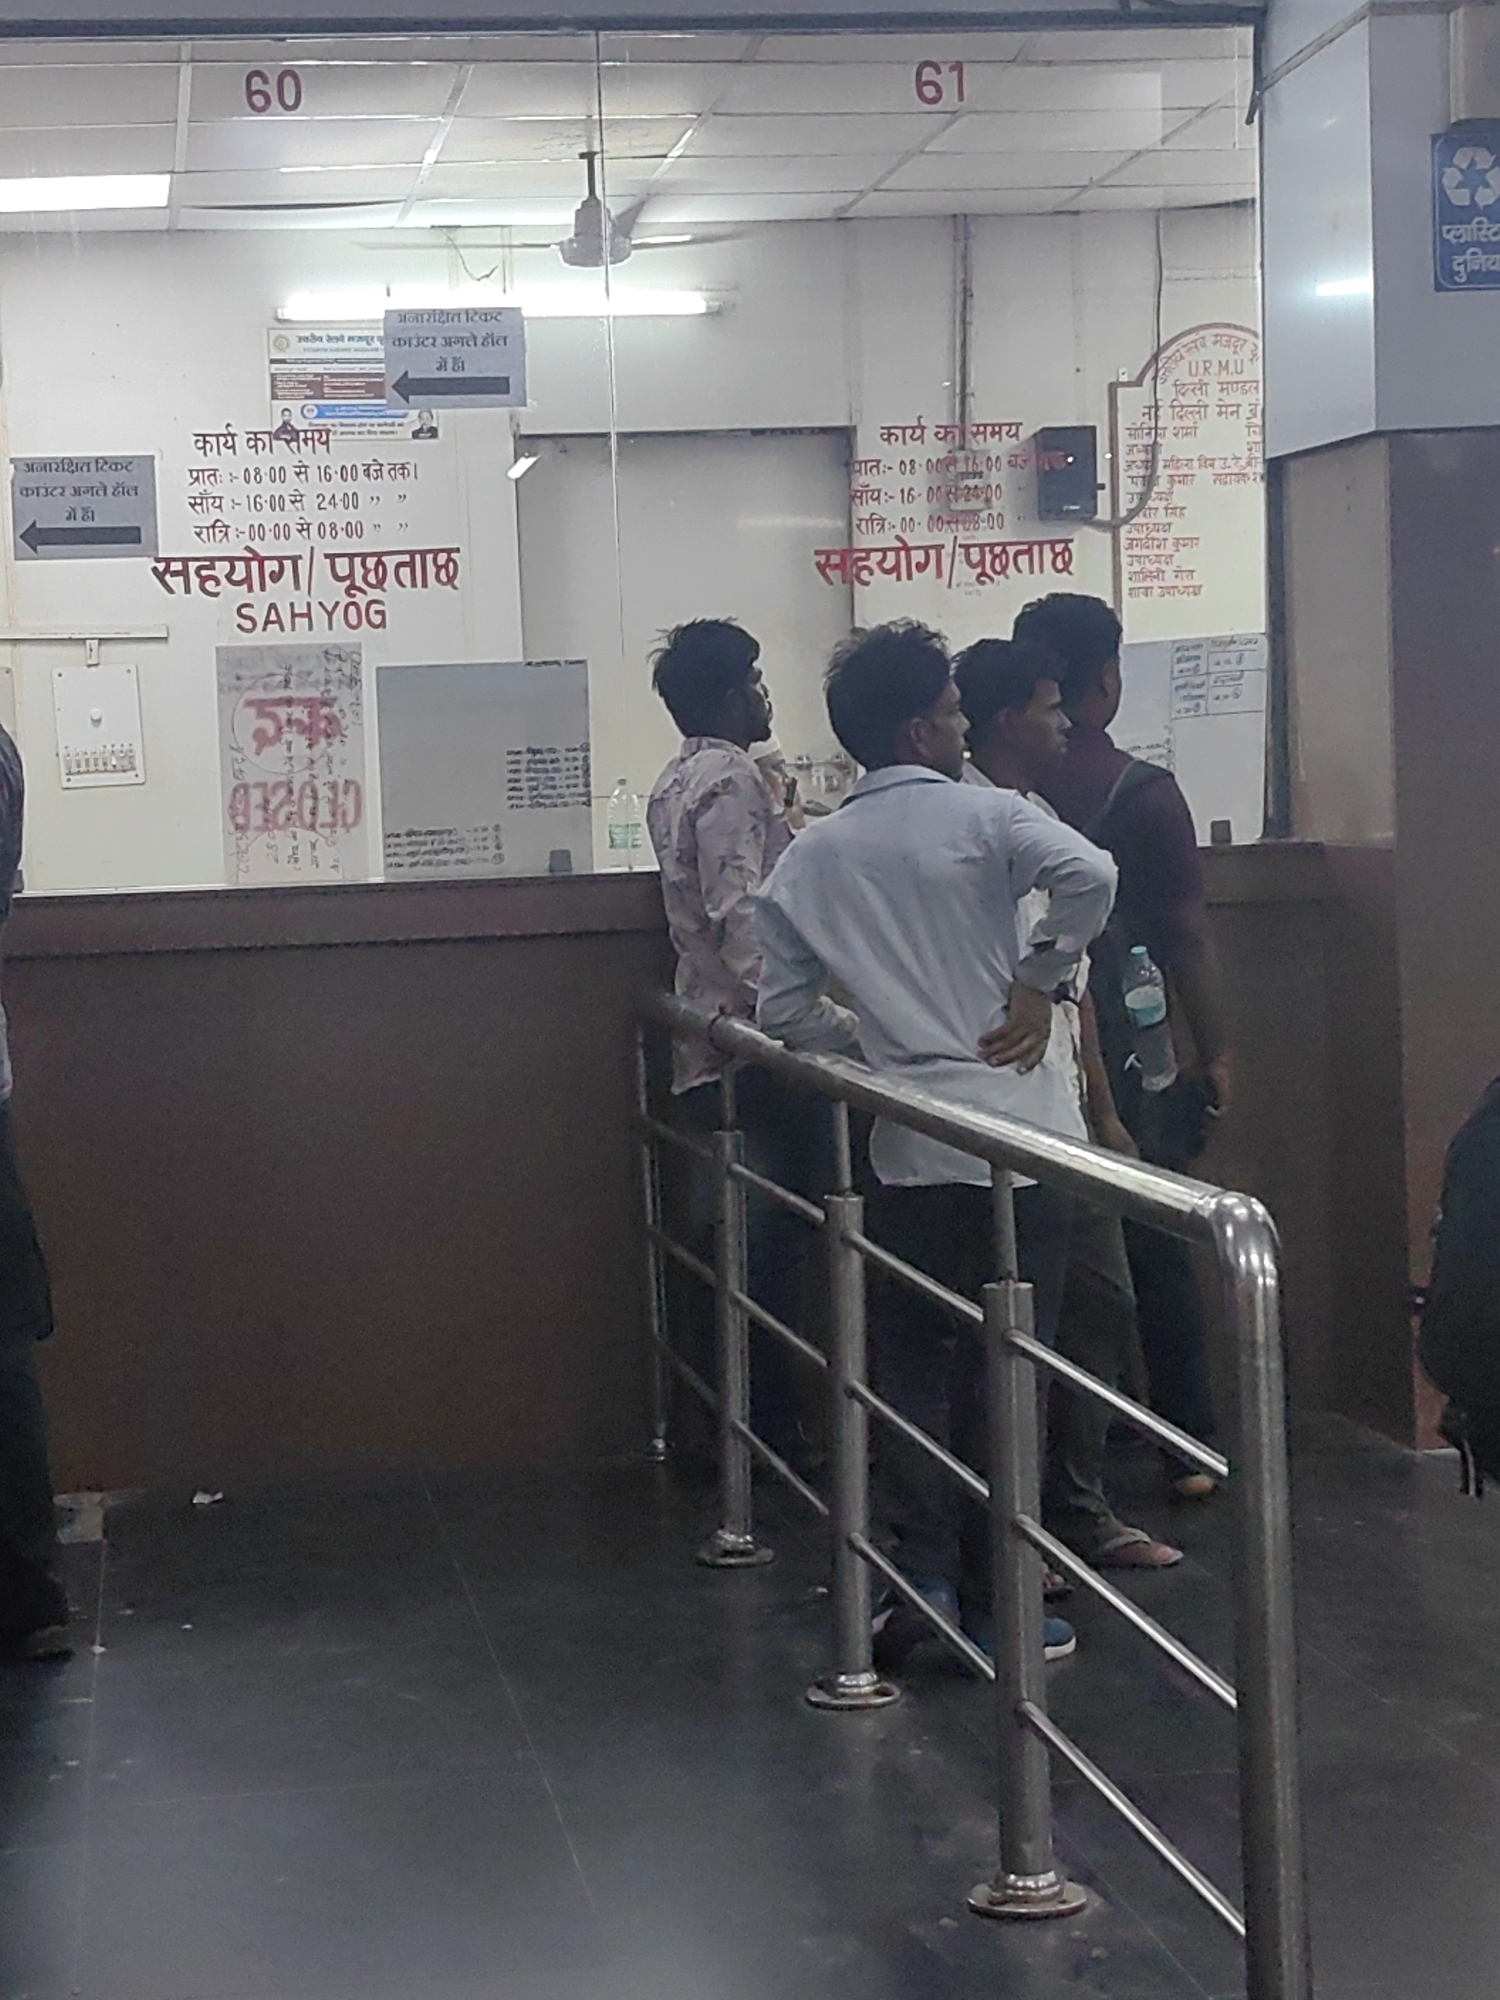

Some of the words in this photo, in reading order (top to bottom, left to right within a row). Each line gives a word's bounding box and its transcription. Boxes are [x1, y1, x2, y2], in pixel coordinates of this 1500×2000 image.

[245, 69, 302, 113] 60
[915, 60, 964, 105] 61
[465, 310, 503, 323] टिकट
[392, 333, 437, 348] काउंटर
[192, 423, 238, 457] कार्य
[245, 431, 274, 456] का
[880, 415, 926, 445] कार्य
[969, 422, 1023, 443] समय
[95, 457, 133, 472] टिकट
[293, 460, 310, 483] से
[362, 459, 384, 481] बजे
[19, 483, 66, 498] काउंटर
[289, 489, 306, 512] से
[193, 519, 231, 544] रात्रि
[296, 517, 313, 541] से
[324, 547, 461, 597] पूछताछ
[236, 599, 387, 633] SAHYOG
